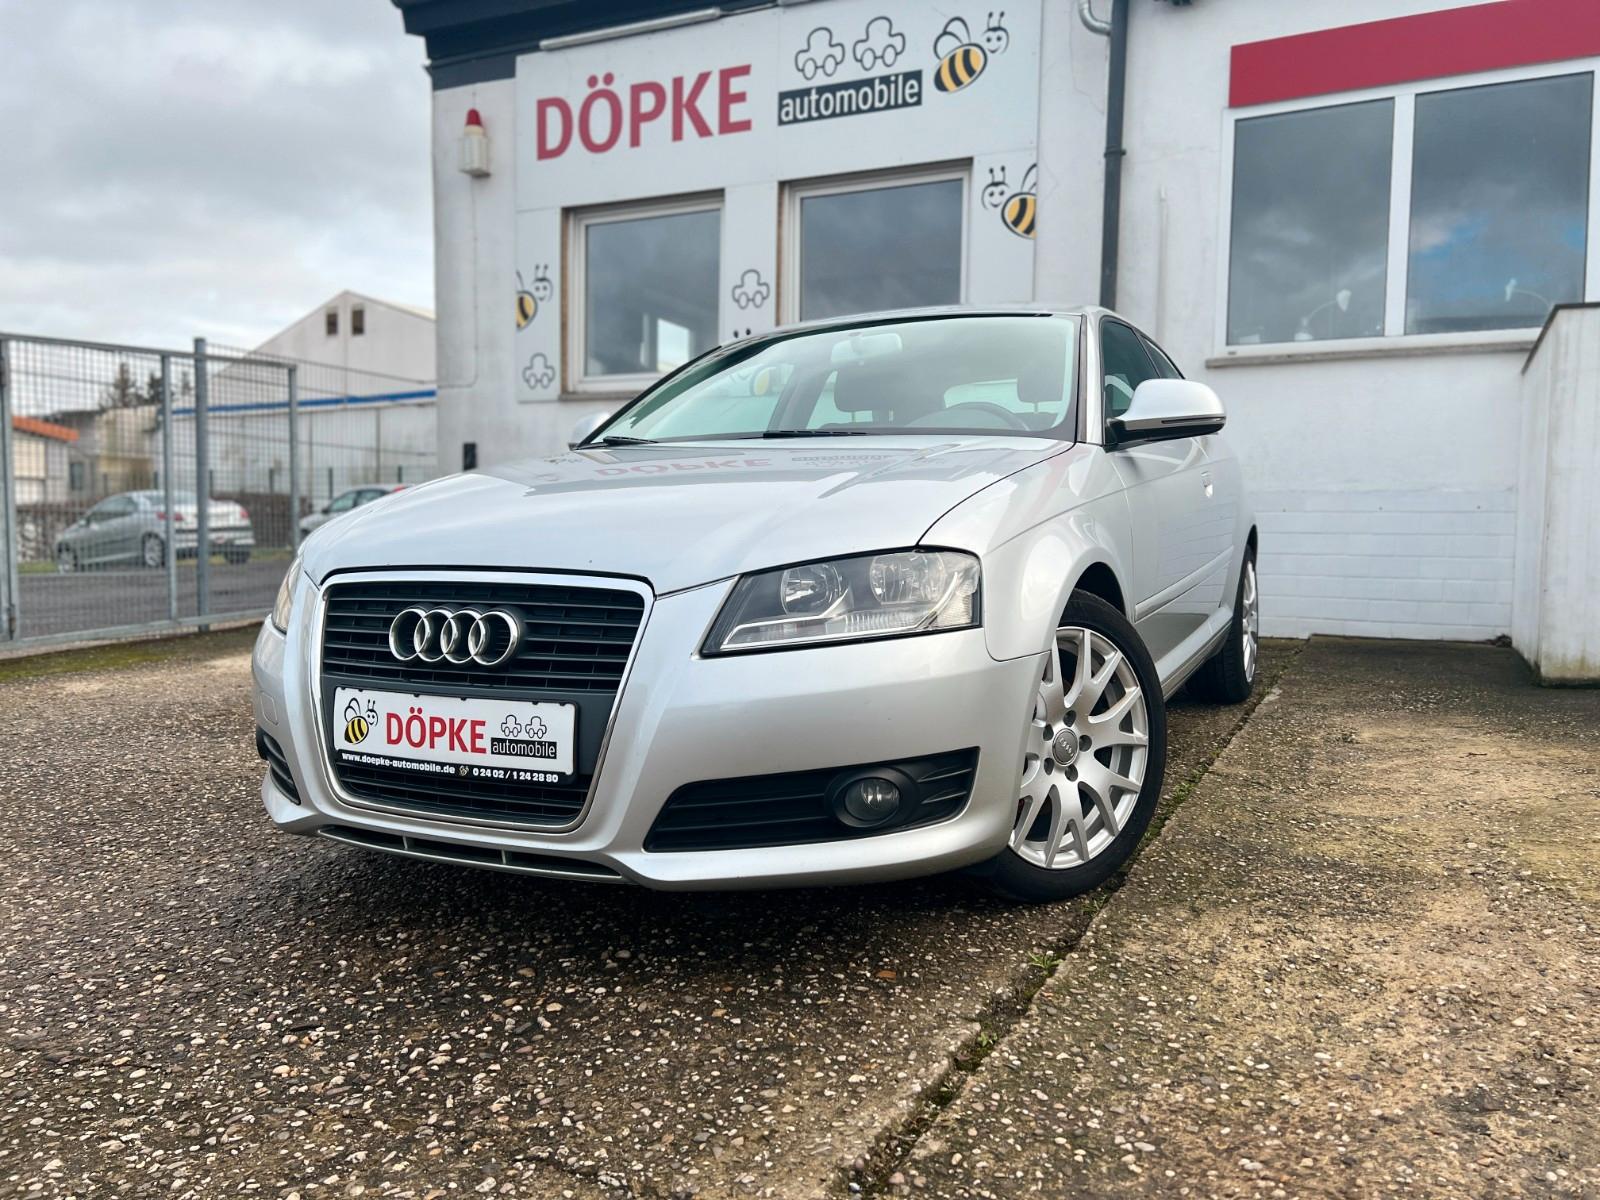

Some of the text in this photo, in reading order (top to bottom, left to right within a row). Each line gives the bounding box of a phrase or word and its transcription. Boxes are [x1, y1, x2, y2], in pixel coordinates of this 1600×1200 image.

[537, 64, 752, 160] DÖPKE
[780, 77, 920, 123] automobile
[386, 706, 487, 754] DÖPKE
[492, 740, 556, 758] automobile
[341, 752, 456, 774] www.doepke-automobile.de
